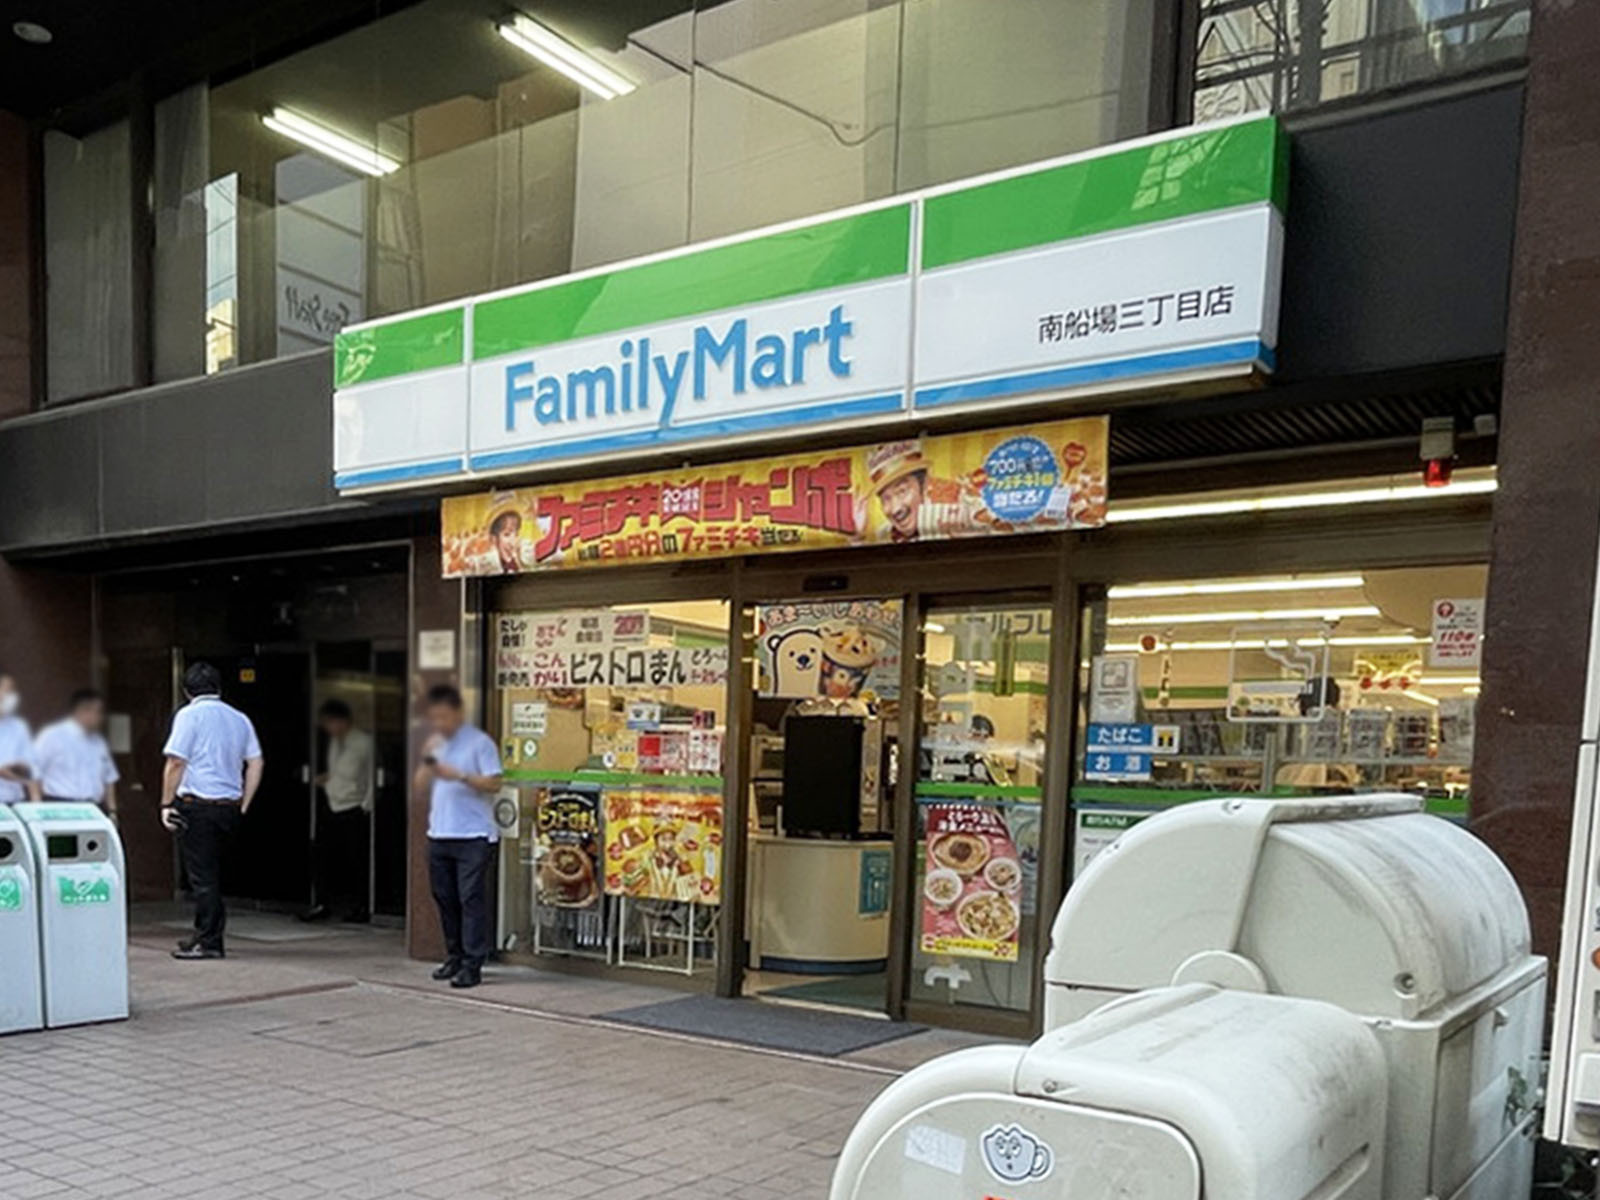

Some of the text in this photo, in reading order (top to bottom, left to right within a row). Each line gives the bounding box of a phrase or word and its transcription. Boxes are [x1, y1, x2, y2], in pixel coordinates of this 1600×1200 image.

[1038, 286, 1235, 344] 南船場三丁目店
[505, 304, 853, 431] FamilyMart
[570, 650, 687, 686] ビストロまん
[1097, 726, 1143, 745] たばこ
